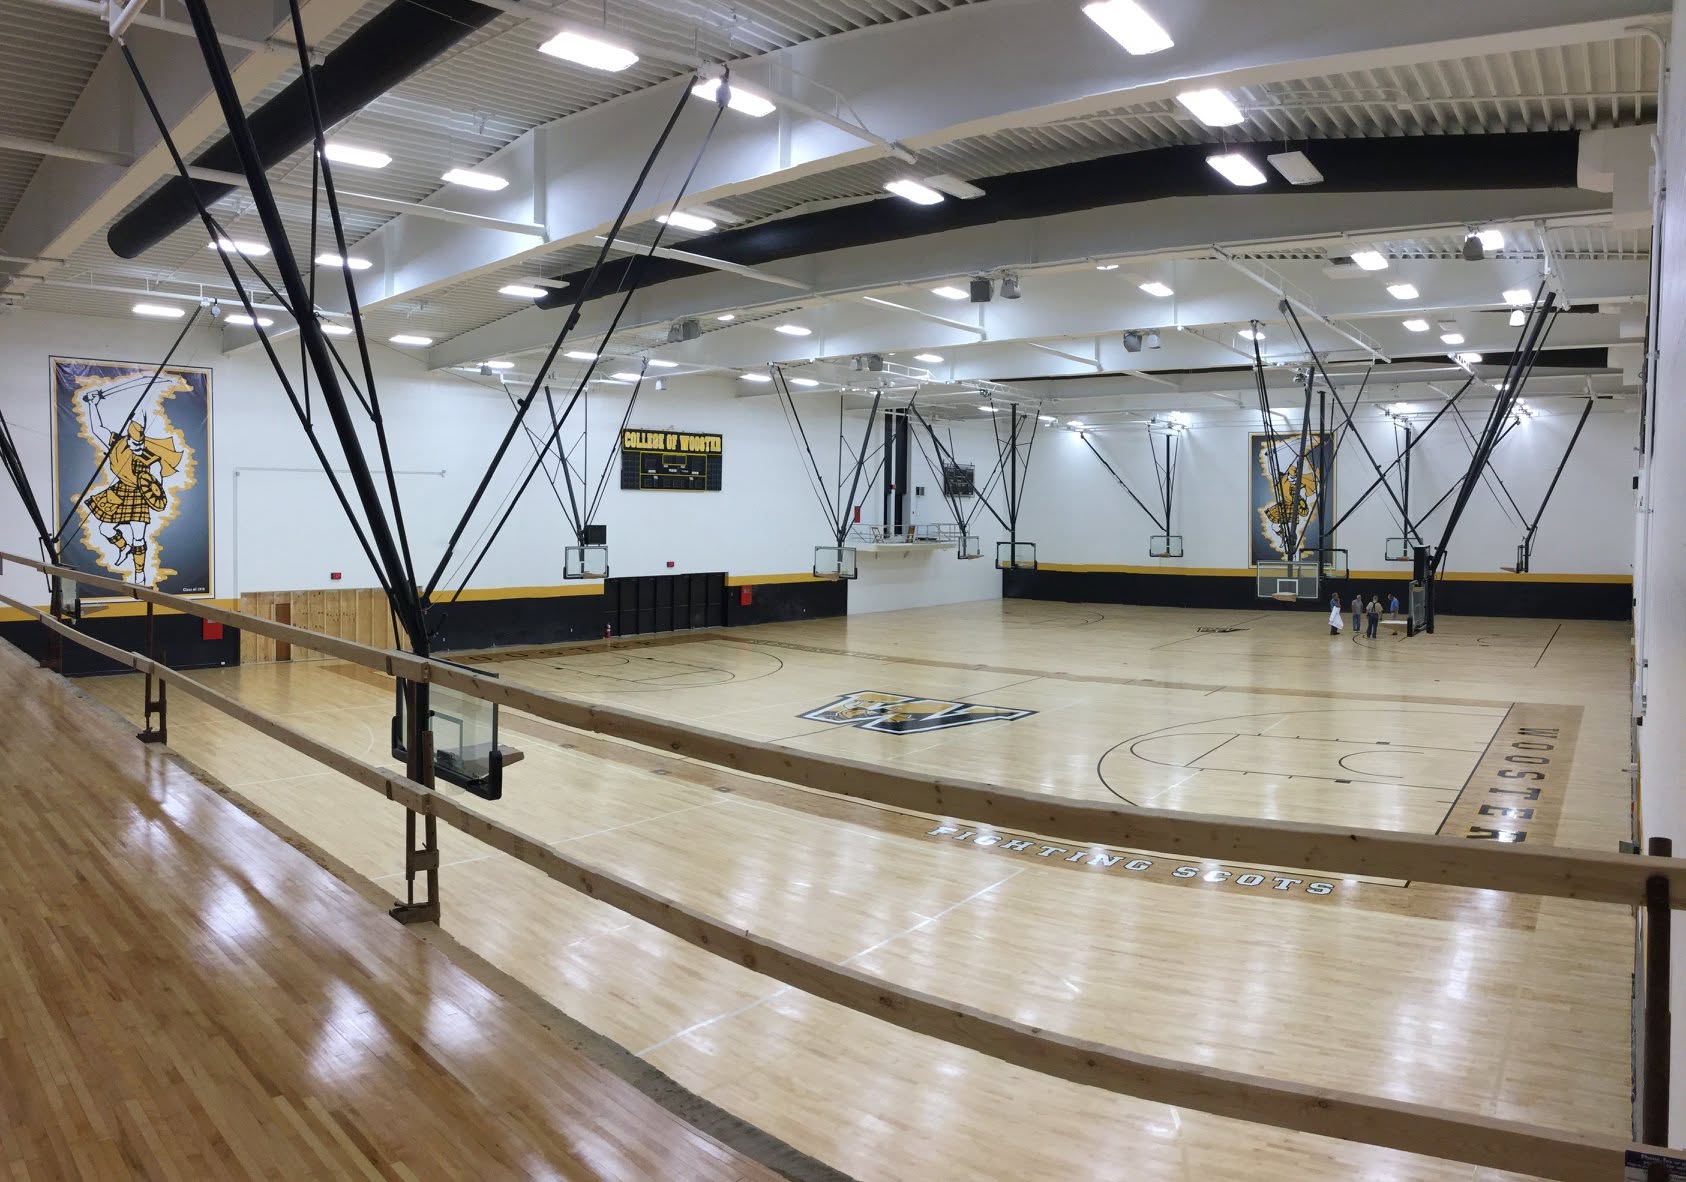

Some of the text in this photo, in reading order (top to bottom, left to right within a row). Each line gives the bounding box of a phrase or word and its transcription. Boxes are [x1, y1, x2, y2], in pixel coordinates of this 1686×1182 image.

[624, 431, 721, 453] COLLEGE OF WOOSTER
[1466, 727, 1560, 843] WOOSTER
[926, 825, 1336, 896] FIGHTING SCOTS
